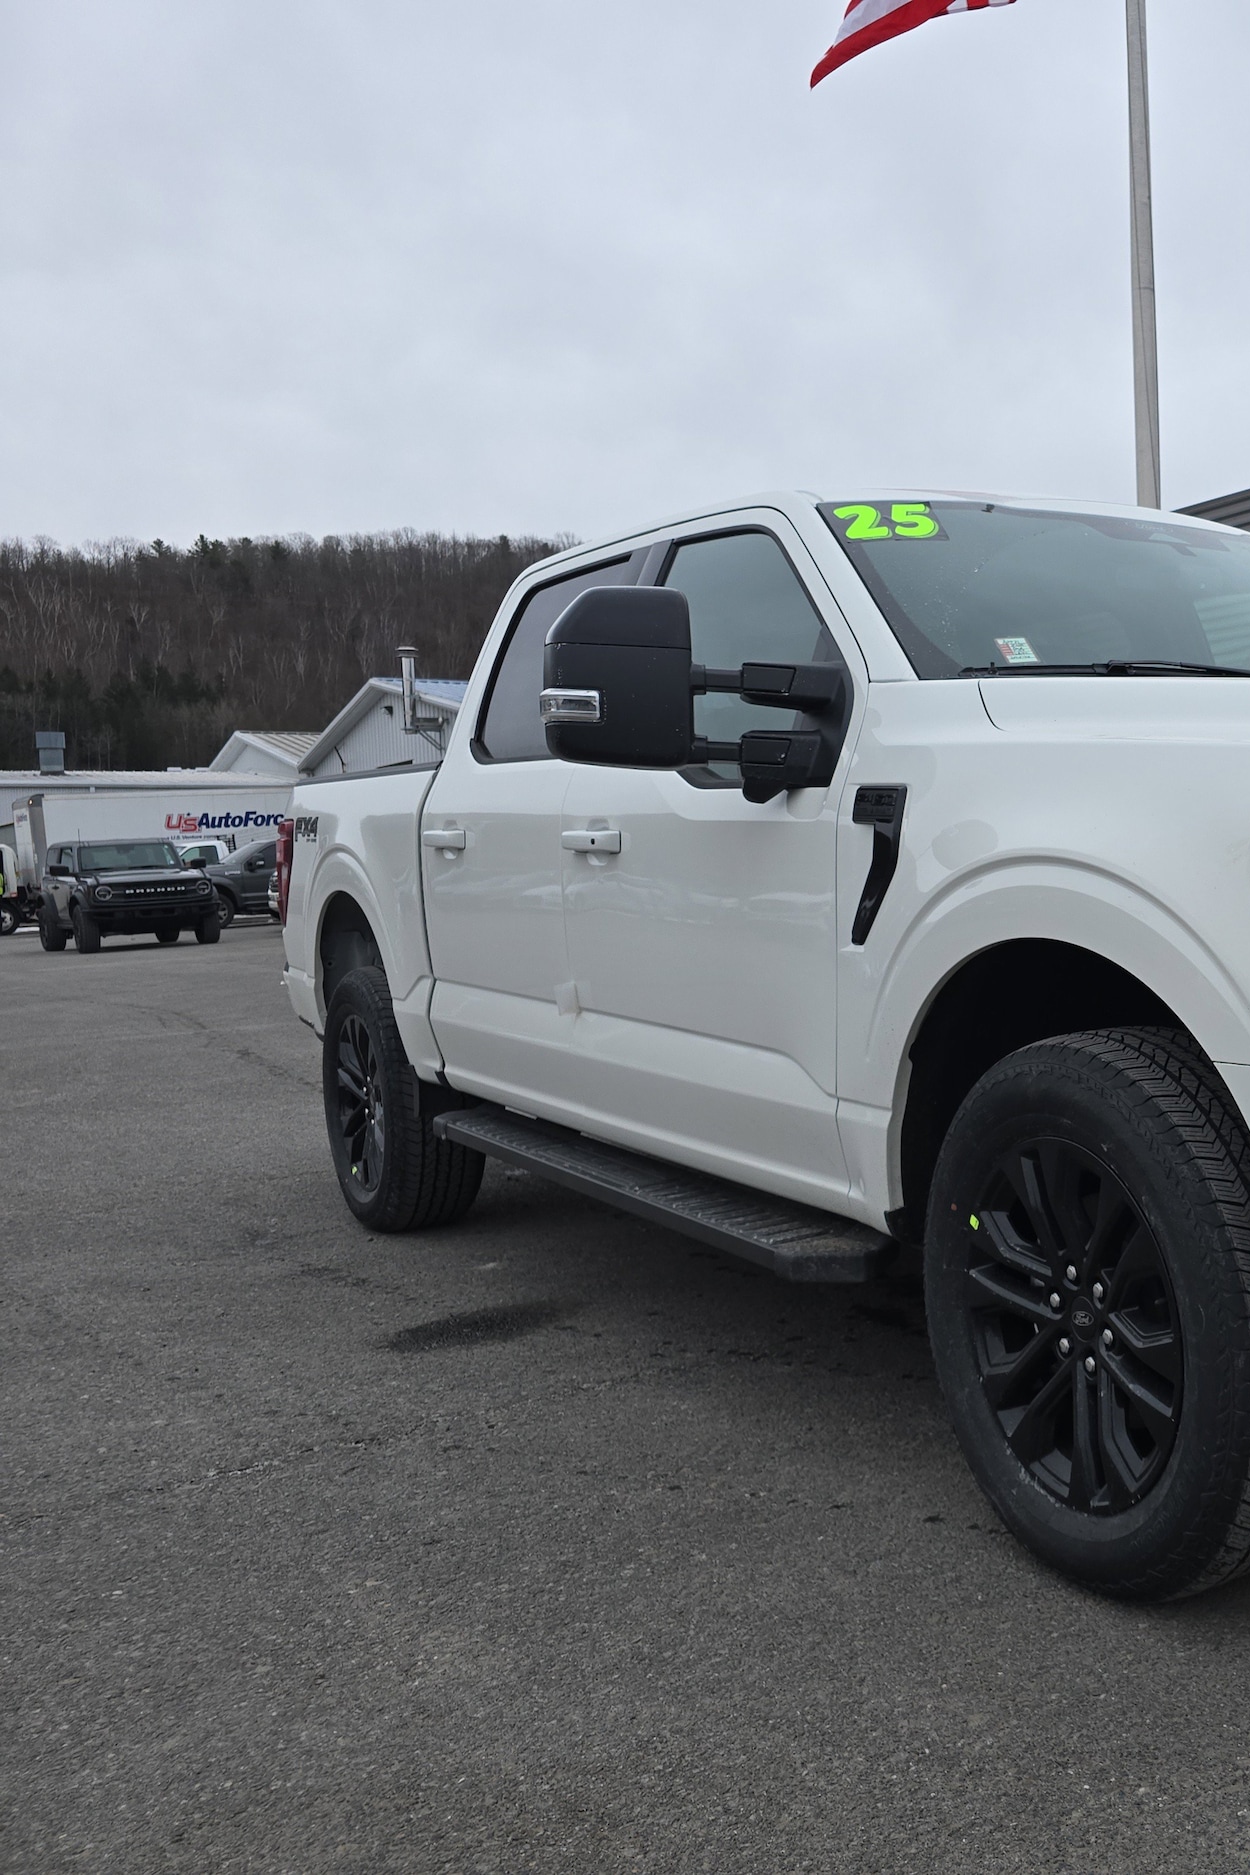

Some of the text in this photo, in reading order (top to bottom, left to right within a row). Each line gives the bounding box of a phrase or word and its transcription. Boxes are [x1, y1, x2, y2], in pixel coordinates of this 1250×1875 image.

[833, 503, 939, 540] 25
[198, 811, 285, 829] AutoForc
[294, 816, 319, 842] FX4
